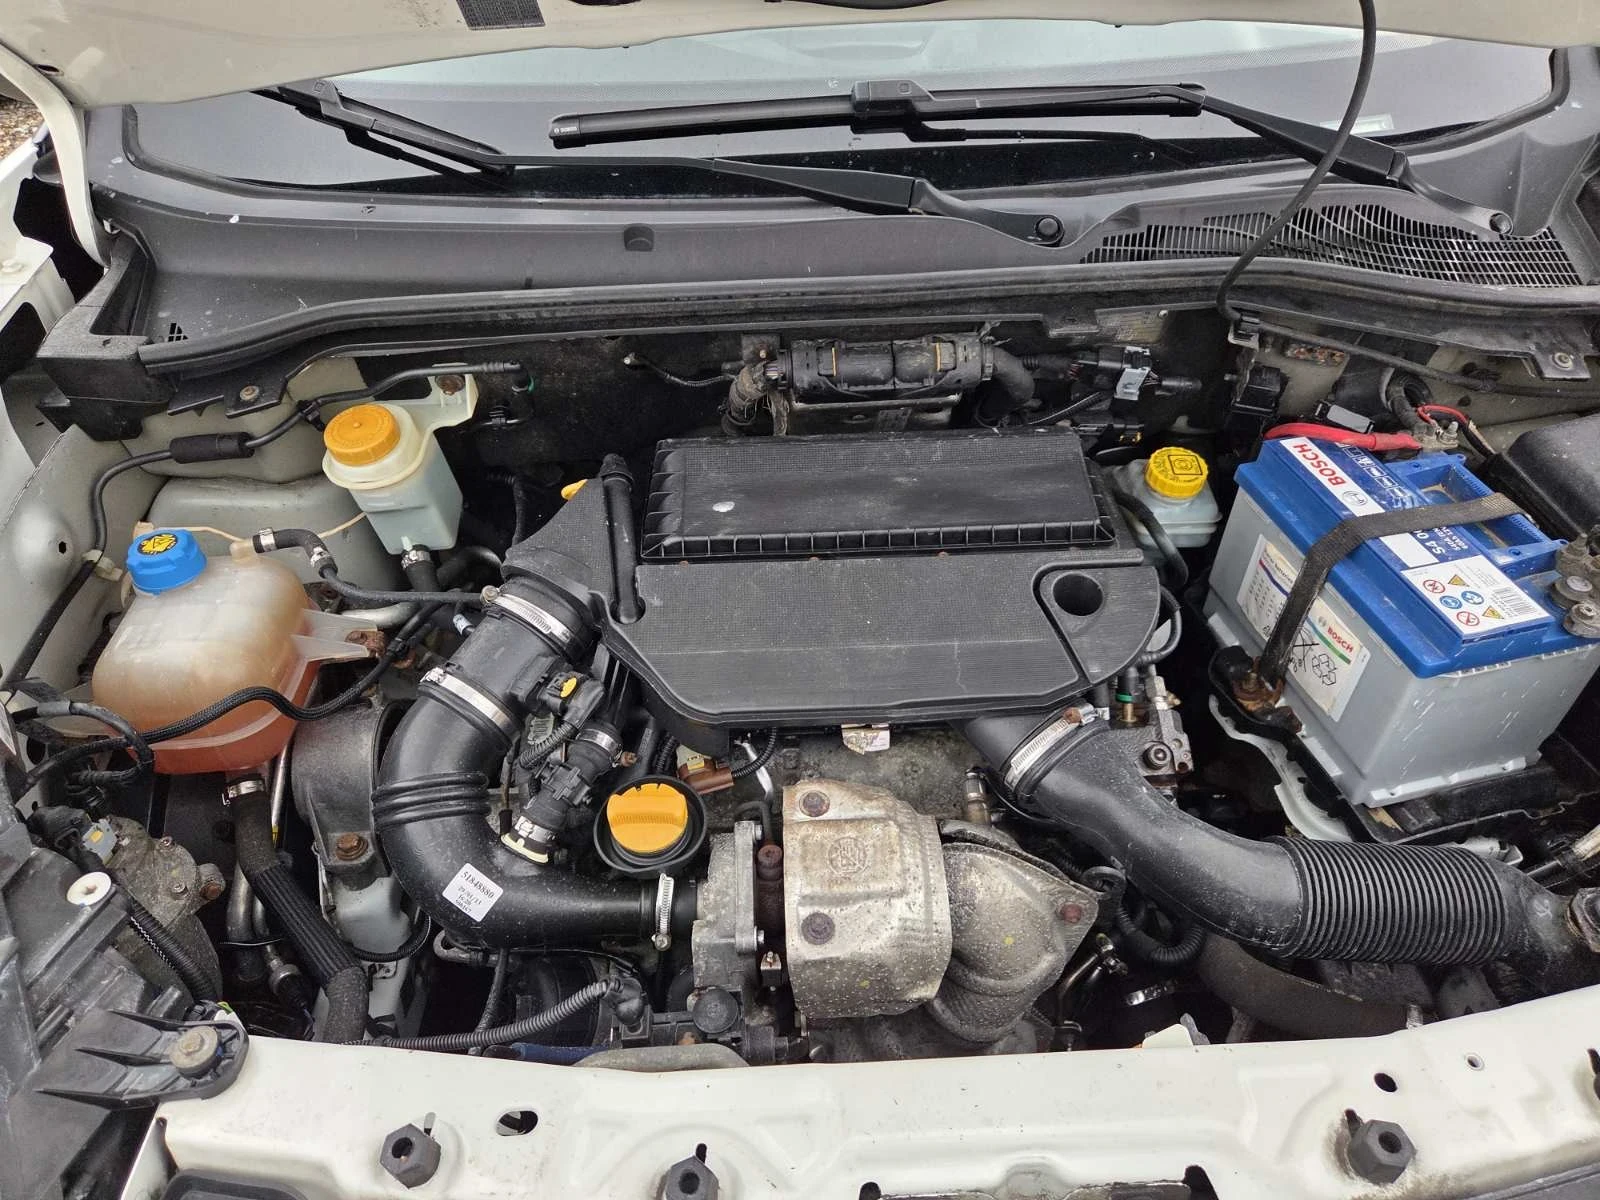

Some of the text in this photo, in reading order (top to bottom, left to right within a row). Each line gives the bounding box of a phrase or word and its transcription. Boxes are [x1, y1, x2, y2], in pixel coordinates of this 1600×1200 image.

[1292, 443, 1347, 486] BOSCH
[1425, 540, 1446, 554] S4
[1327, 626, 1354, 653] BOSCH
